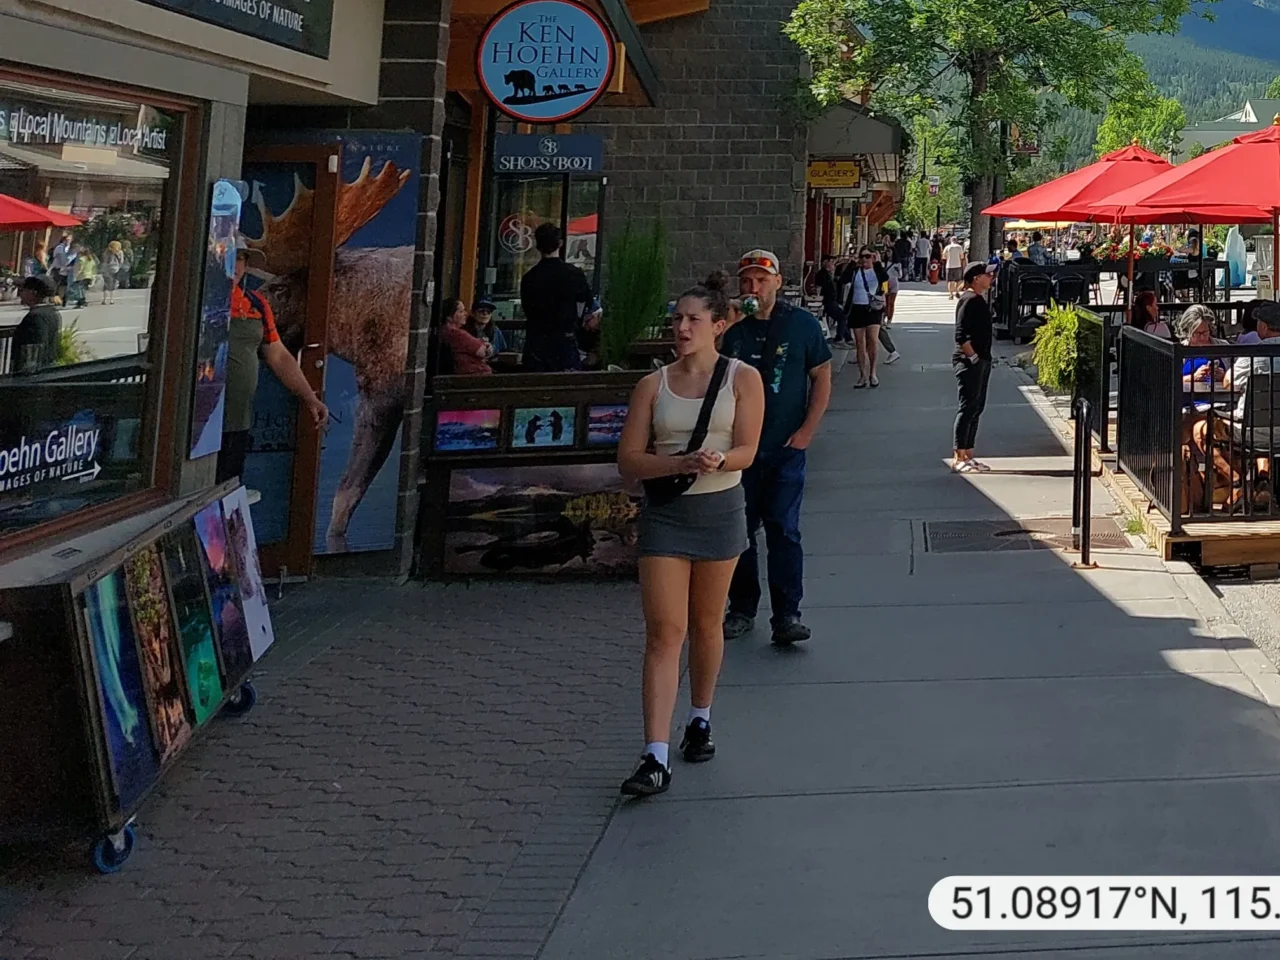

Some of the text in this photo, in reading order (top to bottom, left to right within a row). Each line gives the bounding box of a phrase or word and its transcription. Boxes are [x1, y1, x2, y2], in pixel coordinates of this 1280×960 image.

[259, 0, 271, 20] OF
[272, 7, 304, 32] NATURE
[537, 15, 557, 23] THE
[518, 21, 575, 43] KEN
[491, 42, 599, 65] HOEHN
[536, 66, 602, 79] GALLERY
[19, 108, 51, 136] Local
[53, 113, 106, 143] Mountains
[117, 122, 143, 146] Local
[143, 125, 167, 150] Artist
[499, 155, 551, 171] SHOES
[810, 169, 856, 178] GLACIER'S
[0, 424, 99, 475] oehn Gallery
[34, 469, 47, 483] OF
[49, 459, 84, 478] NATURE
